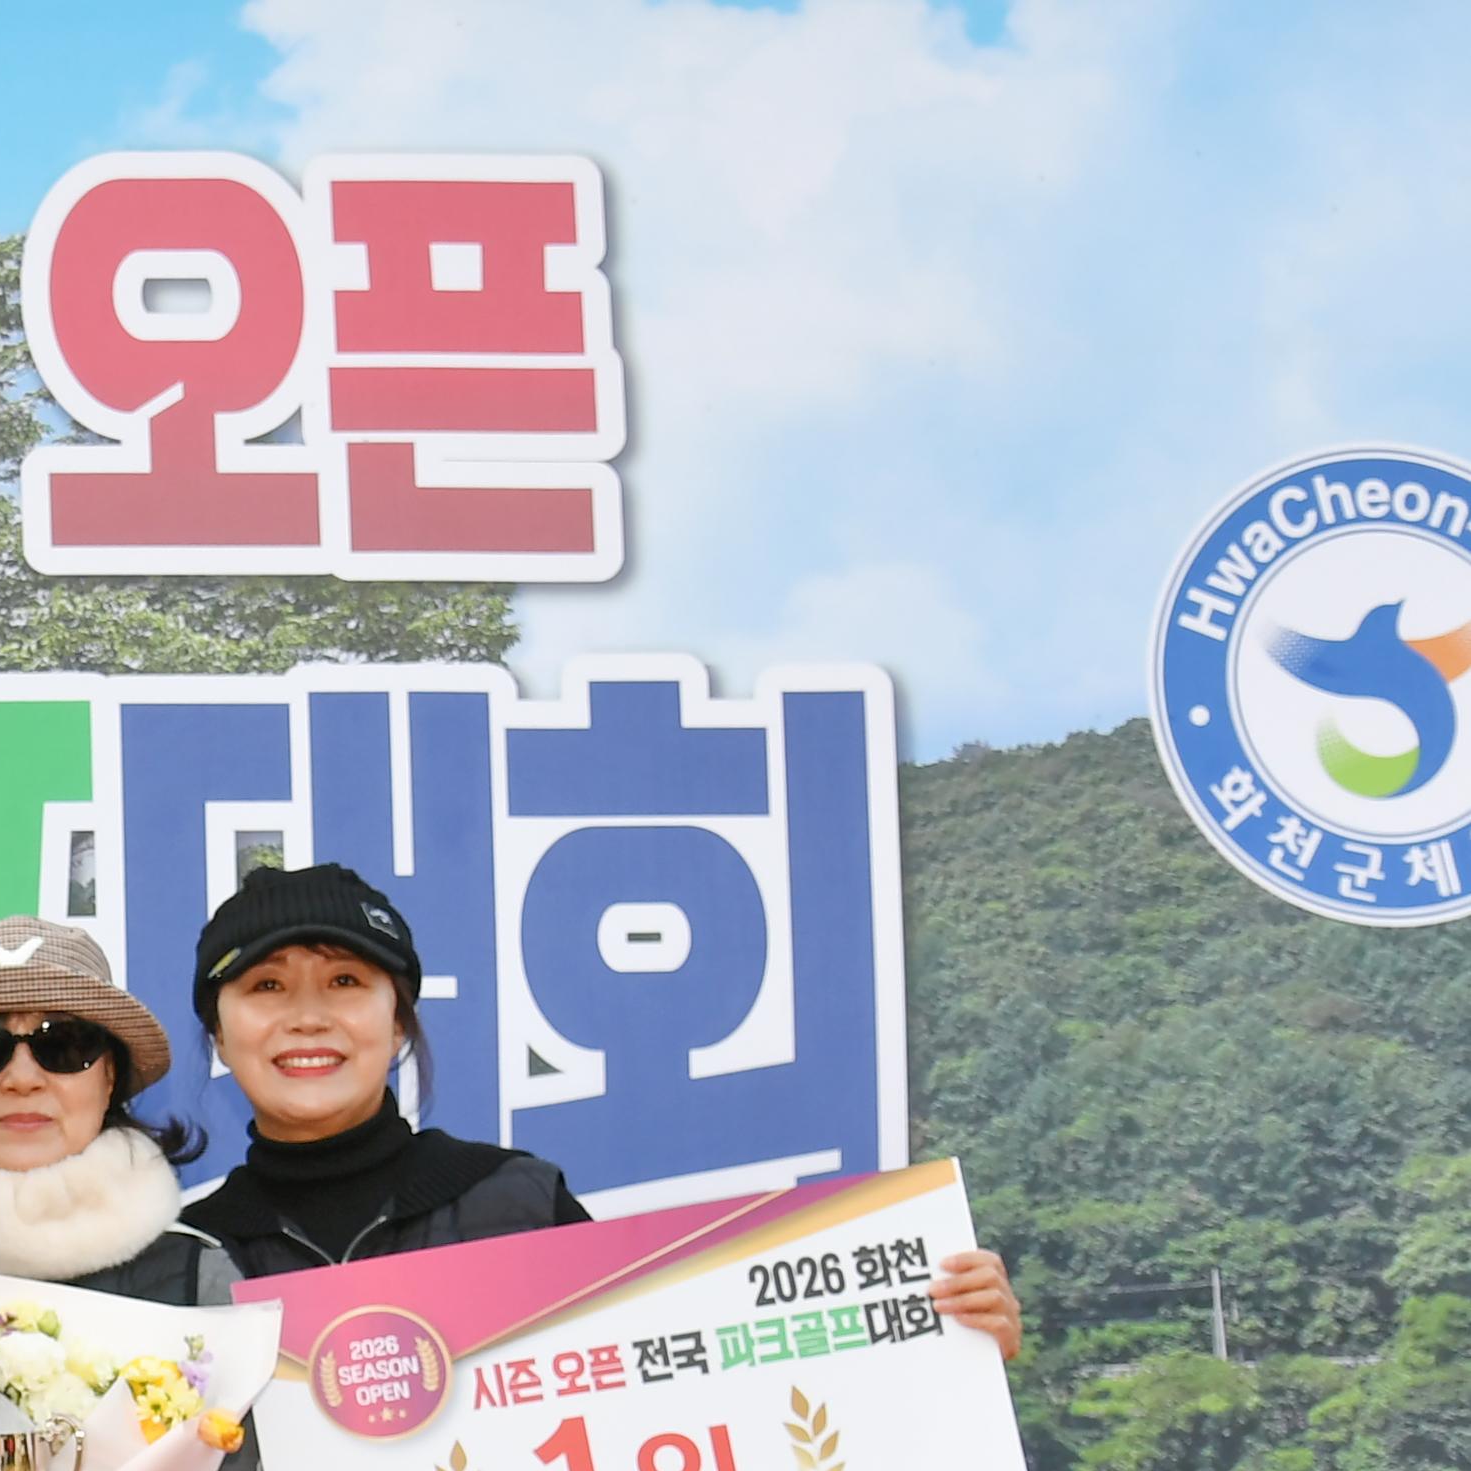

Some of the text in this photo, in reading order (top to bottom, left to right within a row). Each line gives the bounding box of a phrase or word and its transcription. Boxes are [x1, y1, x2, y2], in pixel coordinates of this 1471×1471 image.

[48, 177, 600, 556] 오픈
[1177, 475, 1471, 642] HwaCheon
[1209, 765, 1471, 903] 화천군체
[747, 1237, 931, 1308] 2026 화천
[337, 1355, 420, 1386] SEASON
[349, 1335, 400, 1361] 2026
[355, 1380, 411, 1407] OPEN
[472, 1292, 945, 1412] 시즌 오픈 전국 파크골프대회
